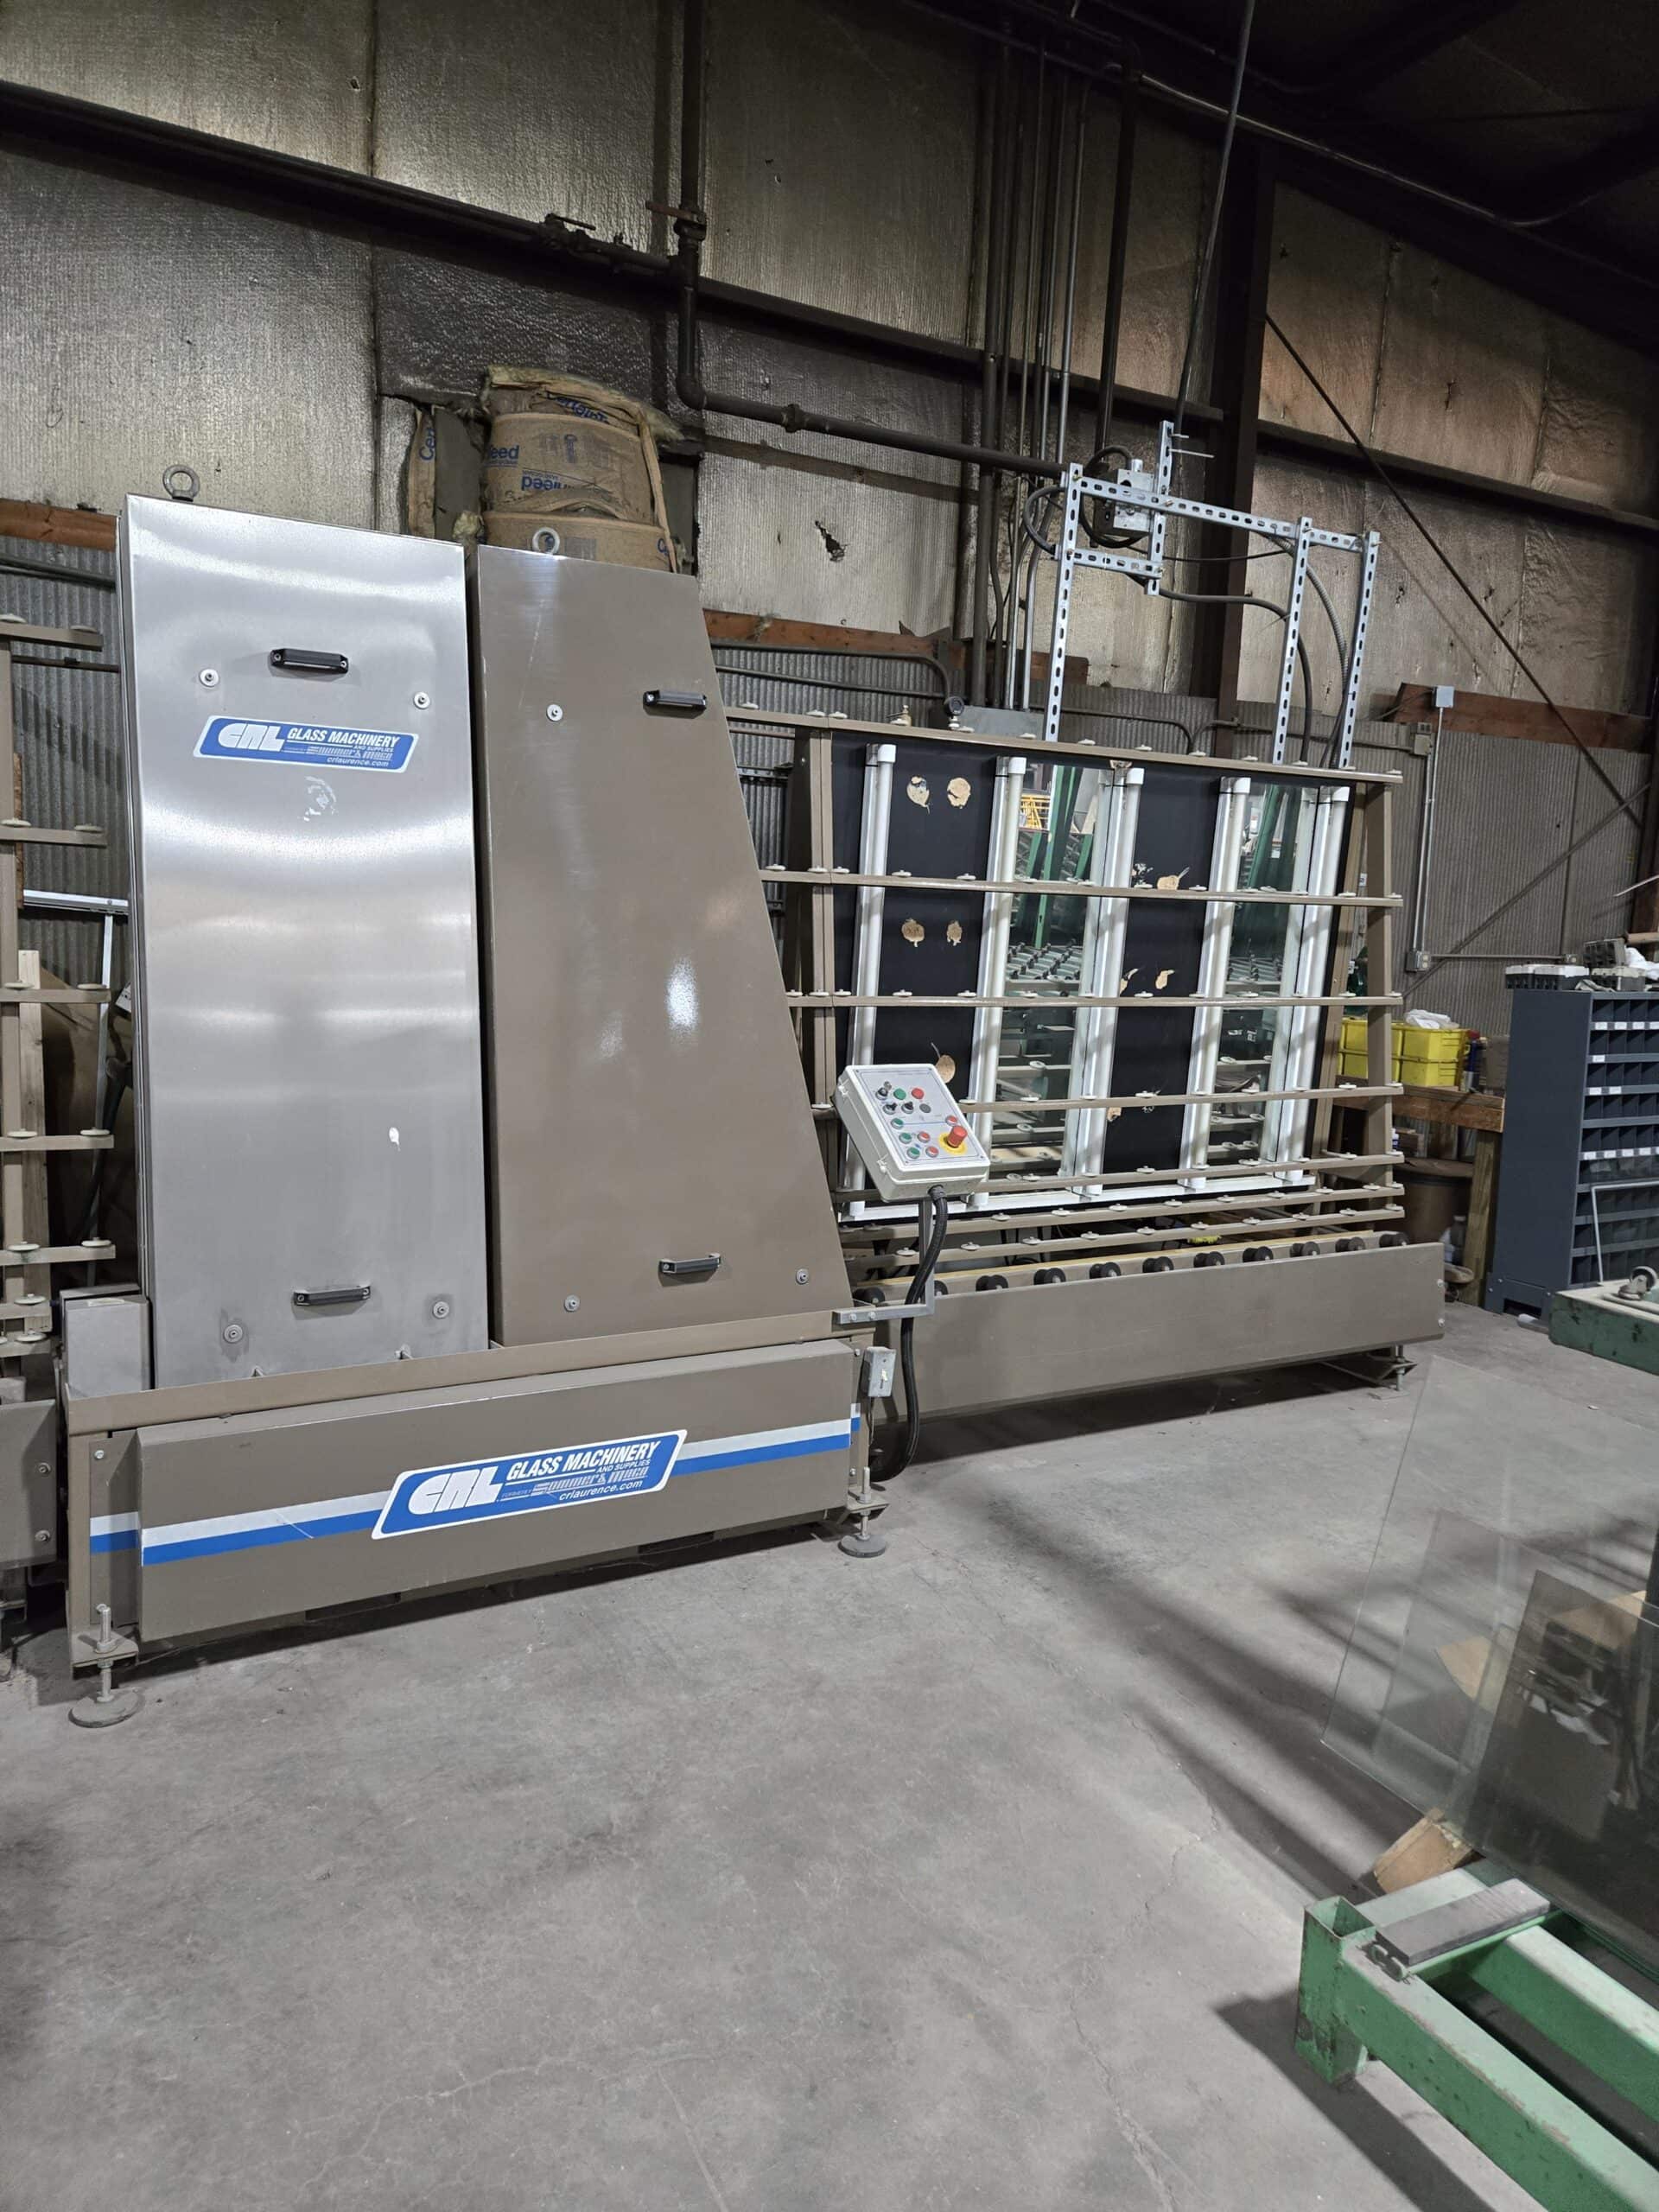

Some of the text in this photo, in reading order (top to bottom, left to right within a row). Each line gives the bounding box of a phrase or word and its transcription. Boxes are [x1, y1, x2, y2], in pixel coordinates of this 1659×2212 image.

[219, 722, 285, 752] CRL
[287, 728, 400, 747] GLASS MACHINERY
[327, 757, 389, 767] crlaurence.com
[506, 1440, 662, 1482] GLASS MACHINERY
[596, 1459, 651, 1474] AND SUPPLIES
[409, 1466, 504, 1515] CRL
[559, 1480, 643, 1501] crlaurence.com
